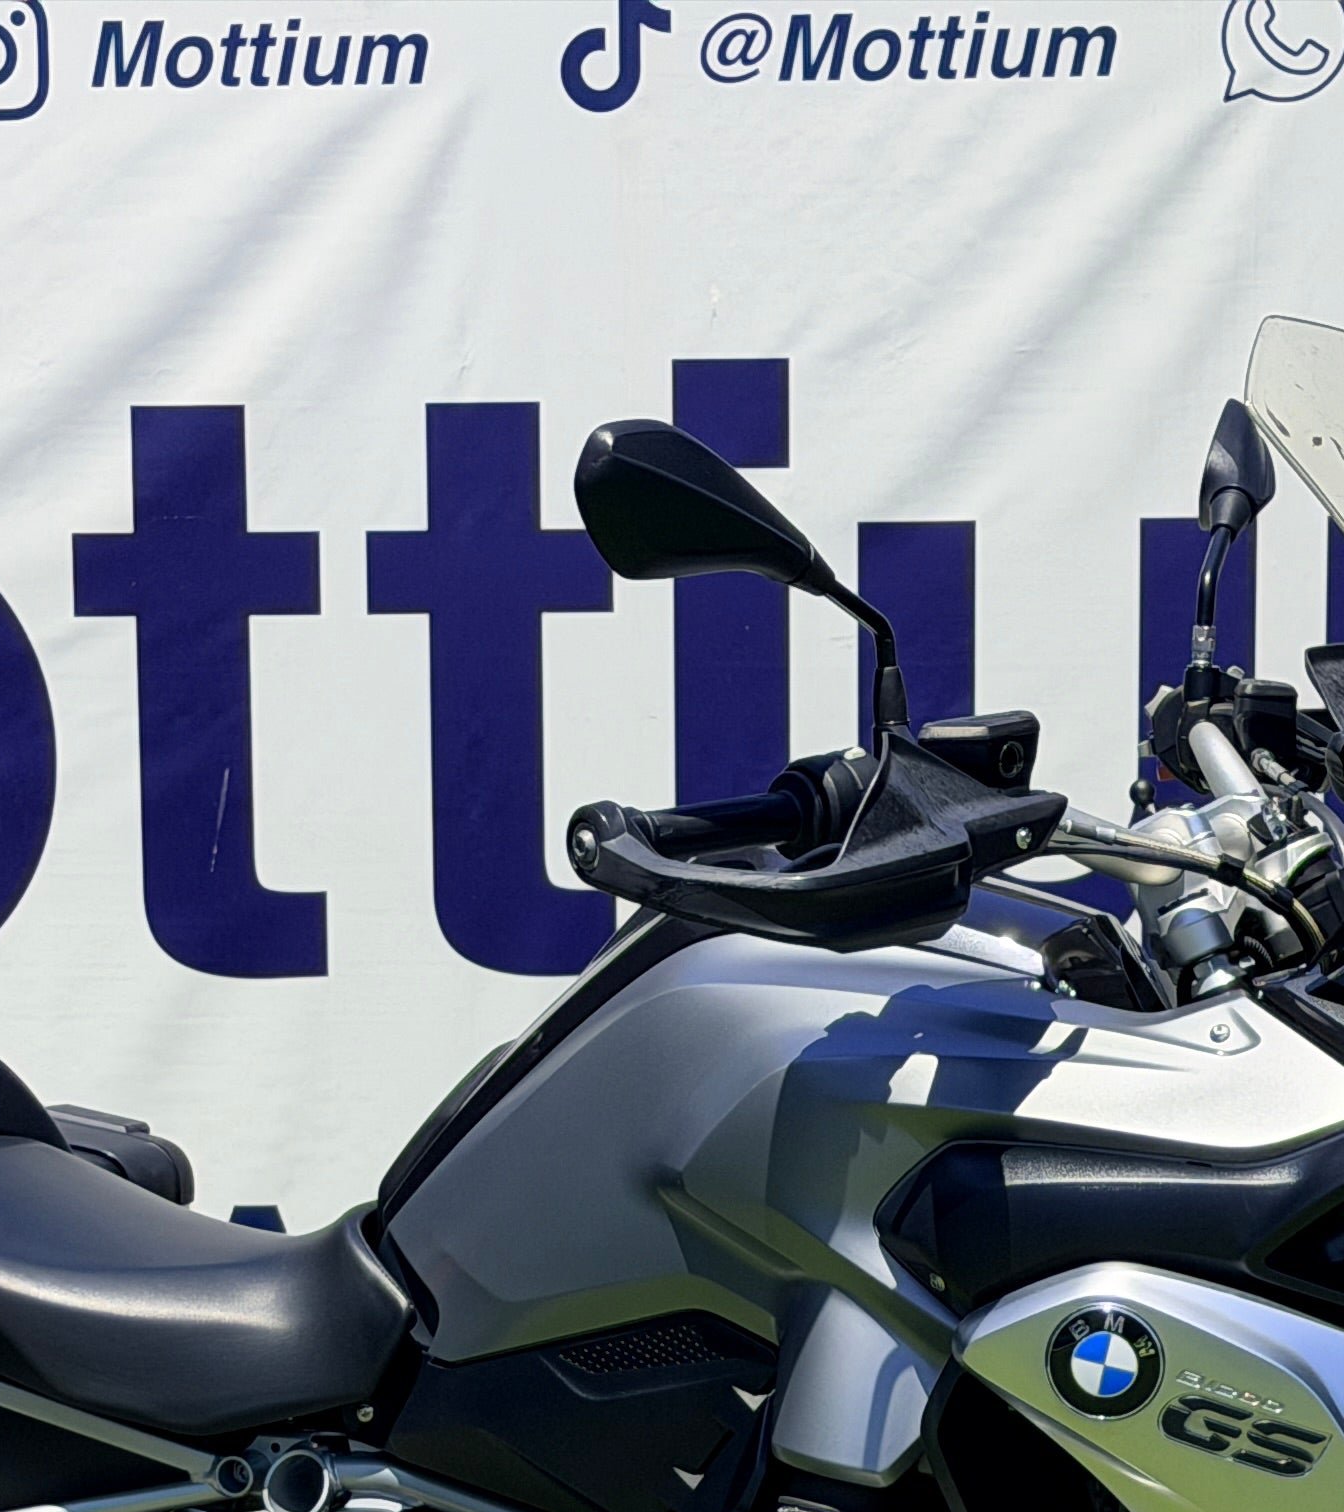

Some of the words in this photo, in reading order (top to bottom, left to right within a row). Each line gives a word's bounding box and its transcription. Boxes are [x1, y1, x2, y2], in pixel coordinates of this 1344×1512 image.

[91, 18, 429, 89] Mottium
[700, 10, 1118, 84] @Mottium
[1068, 1311, 1156, 1358] BMW
[1157, 1394, 1334, 1478] GS
